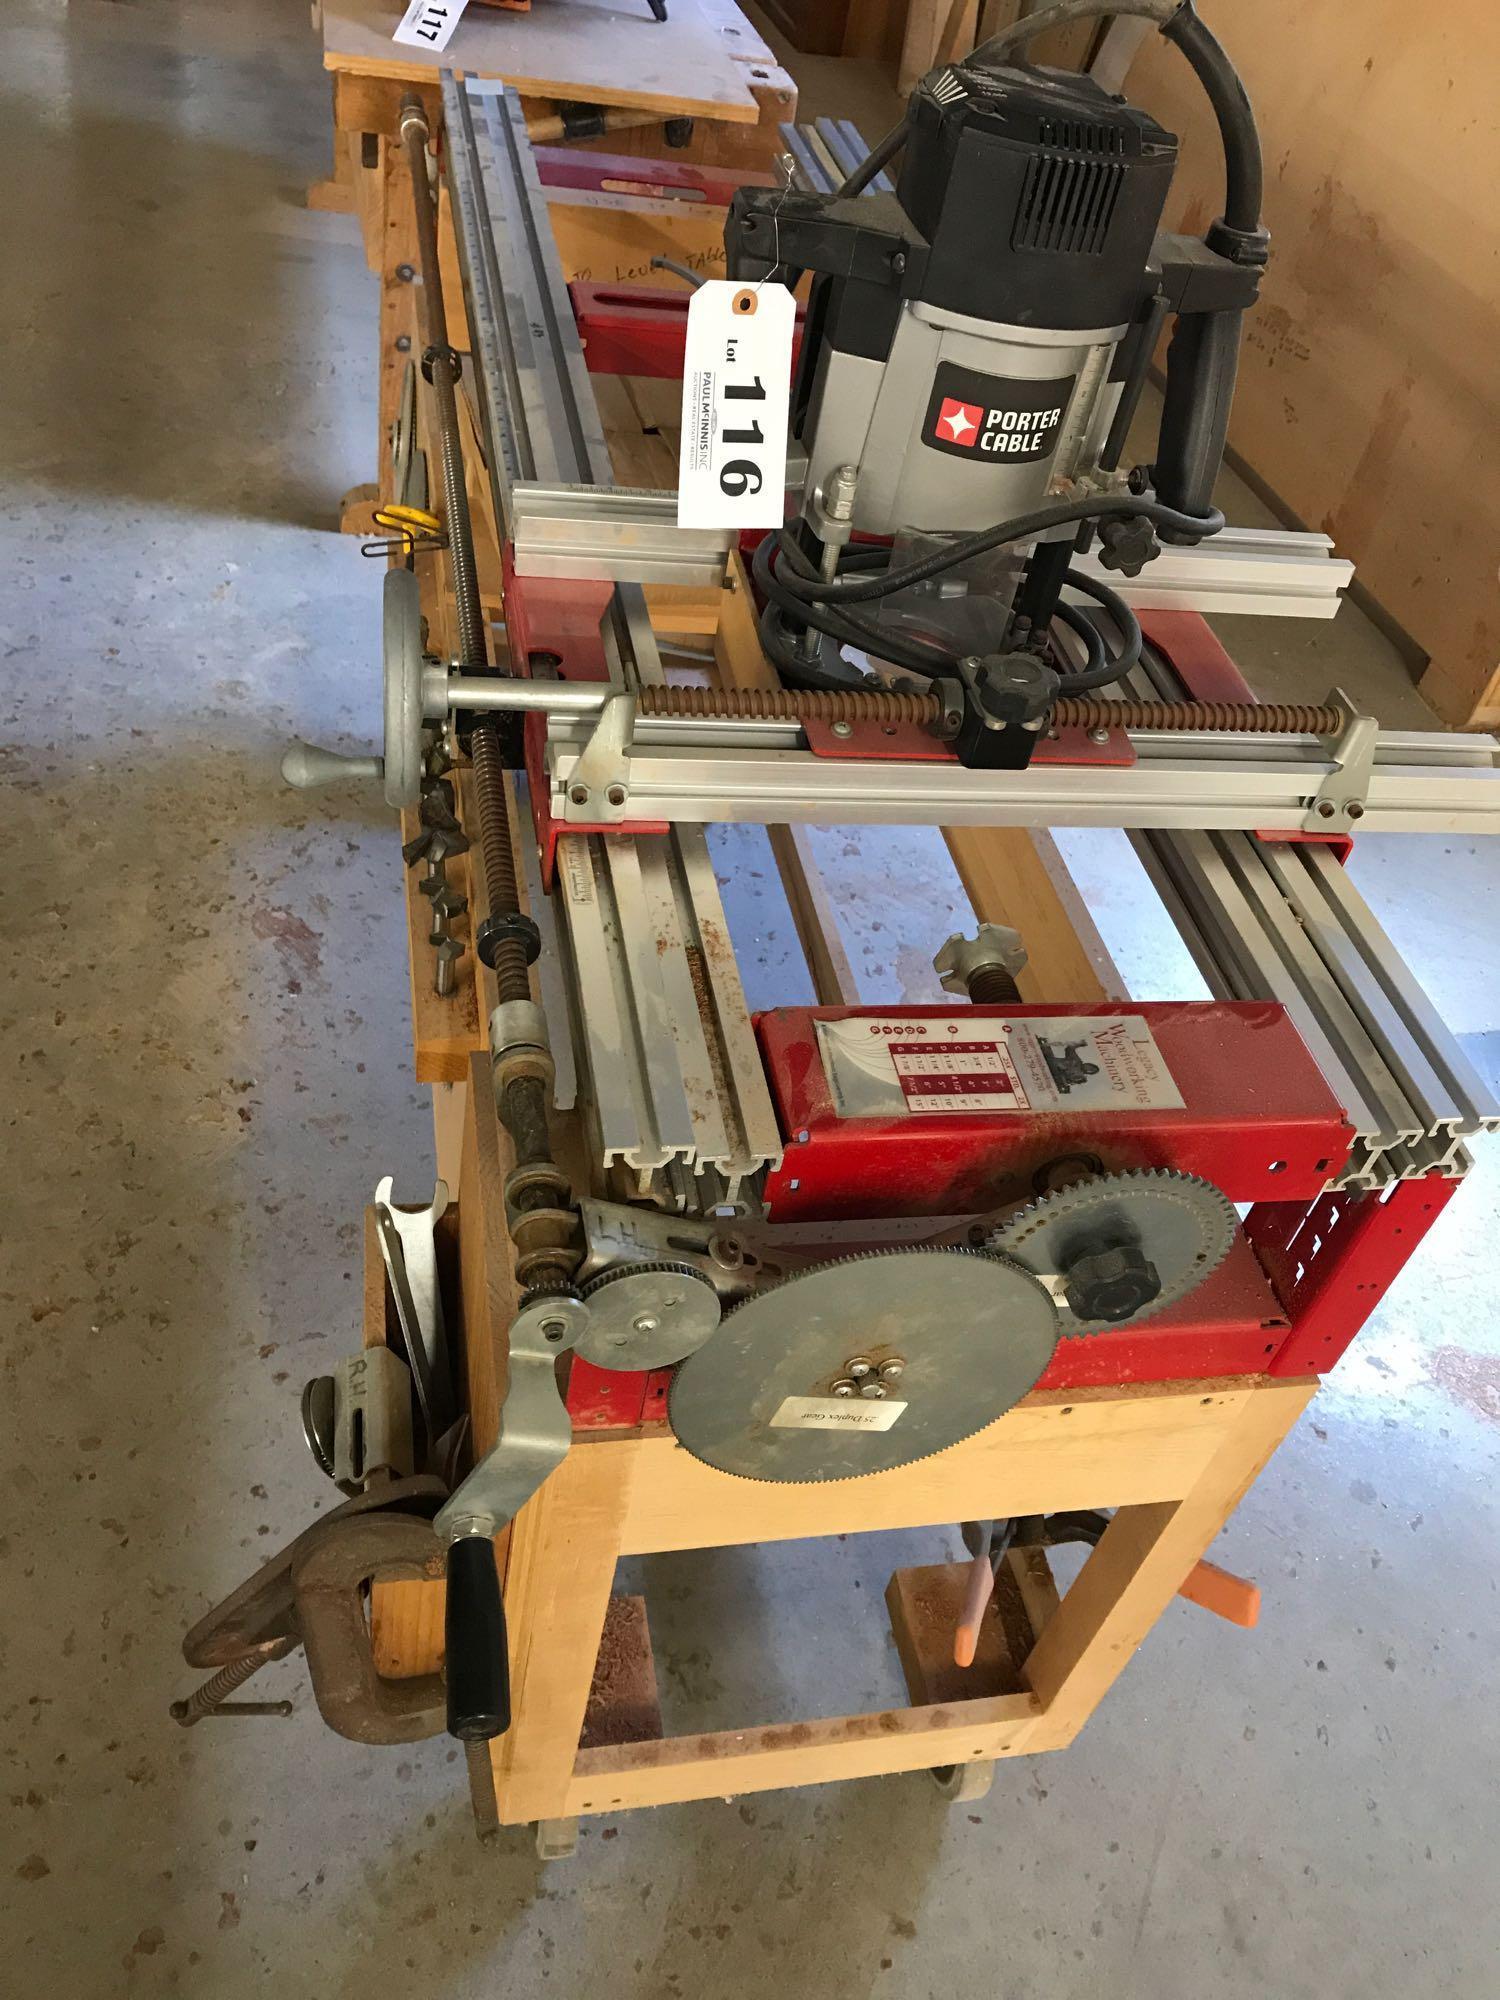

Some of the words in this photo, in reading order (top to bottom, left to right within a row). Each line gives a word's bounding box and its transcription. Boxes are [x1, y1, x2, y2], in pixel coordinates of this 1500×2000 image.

[417, 8, 448, 41] 117
[726, 339, 738, 362] Lot
[986, 408, 1061, 431] PORTER
[720, 376, 766, 497] 116
[980, 432, 1043, 452] CABLE
[1091, 1031, 1128, 1094] Machinery
[1108, 1023, 1151, 1104] Woodworking
[1132, 1039, 1160, 1082] Legacy
[800, 1413, 826, 1421] Gear
[828, 1413, 863, 1423] Duplex
